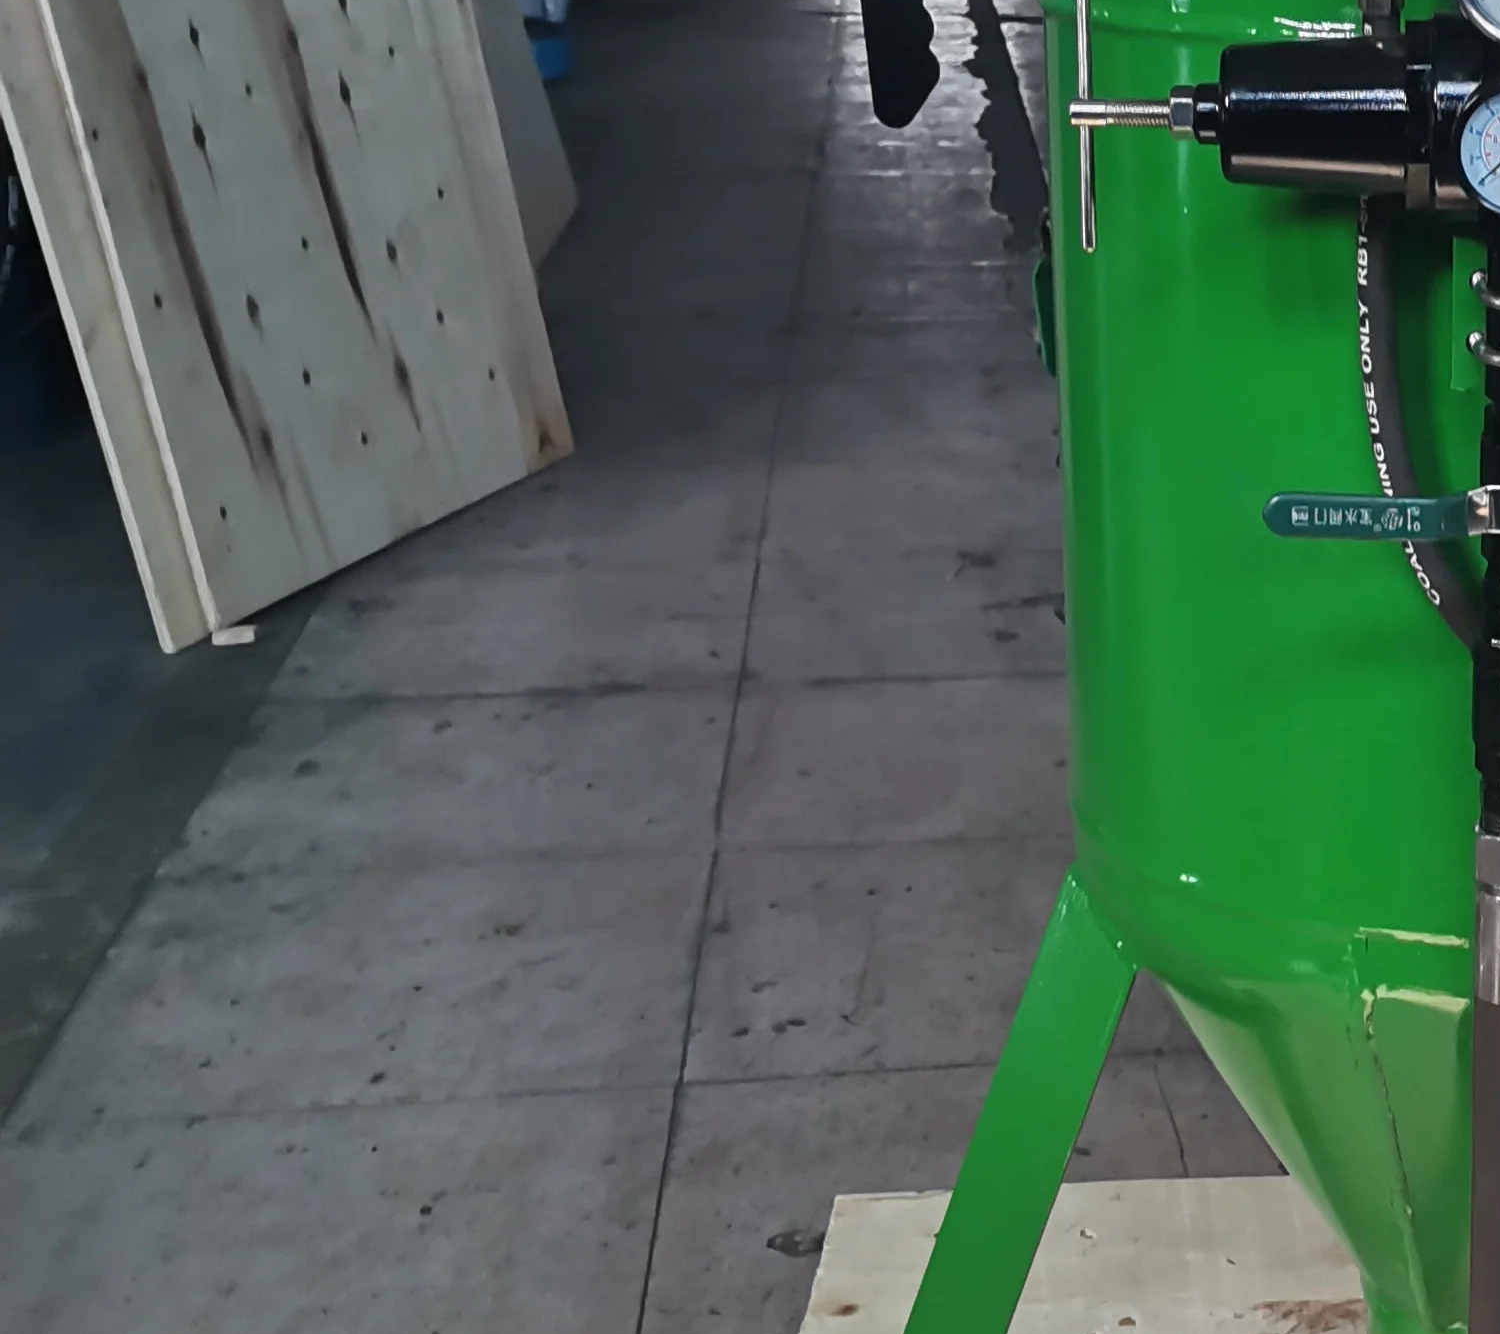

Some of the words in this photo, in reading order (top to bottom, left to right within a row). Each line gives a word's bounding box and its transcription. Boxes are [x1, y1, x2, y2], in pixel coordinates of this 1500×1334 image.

[1357, 300, 1374, 375] ONLY
[1363, 381, 1380, 435] USE
[1402, 537, 1441, 606] COAL
